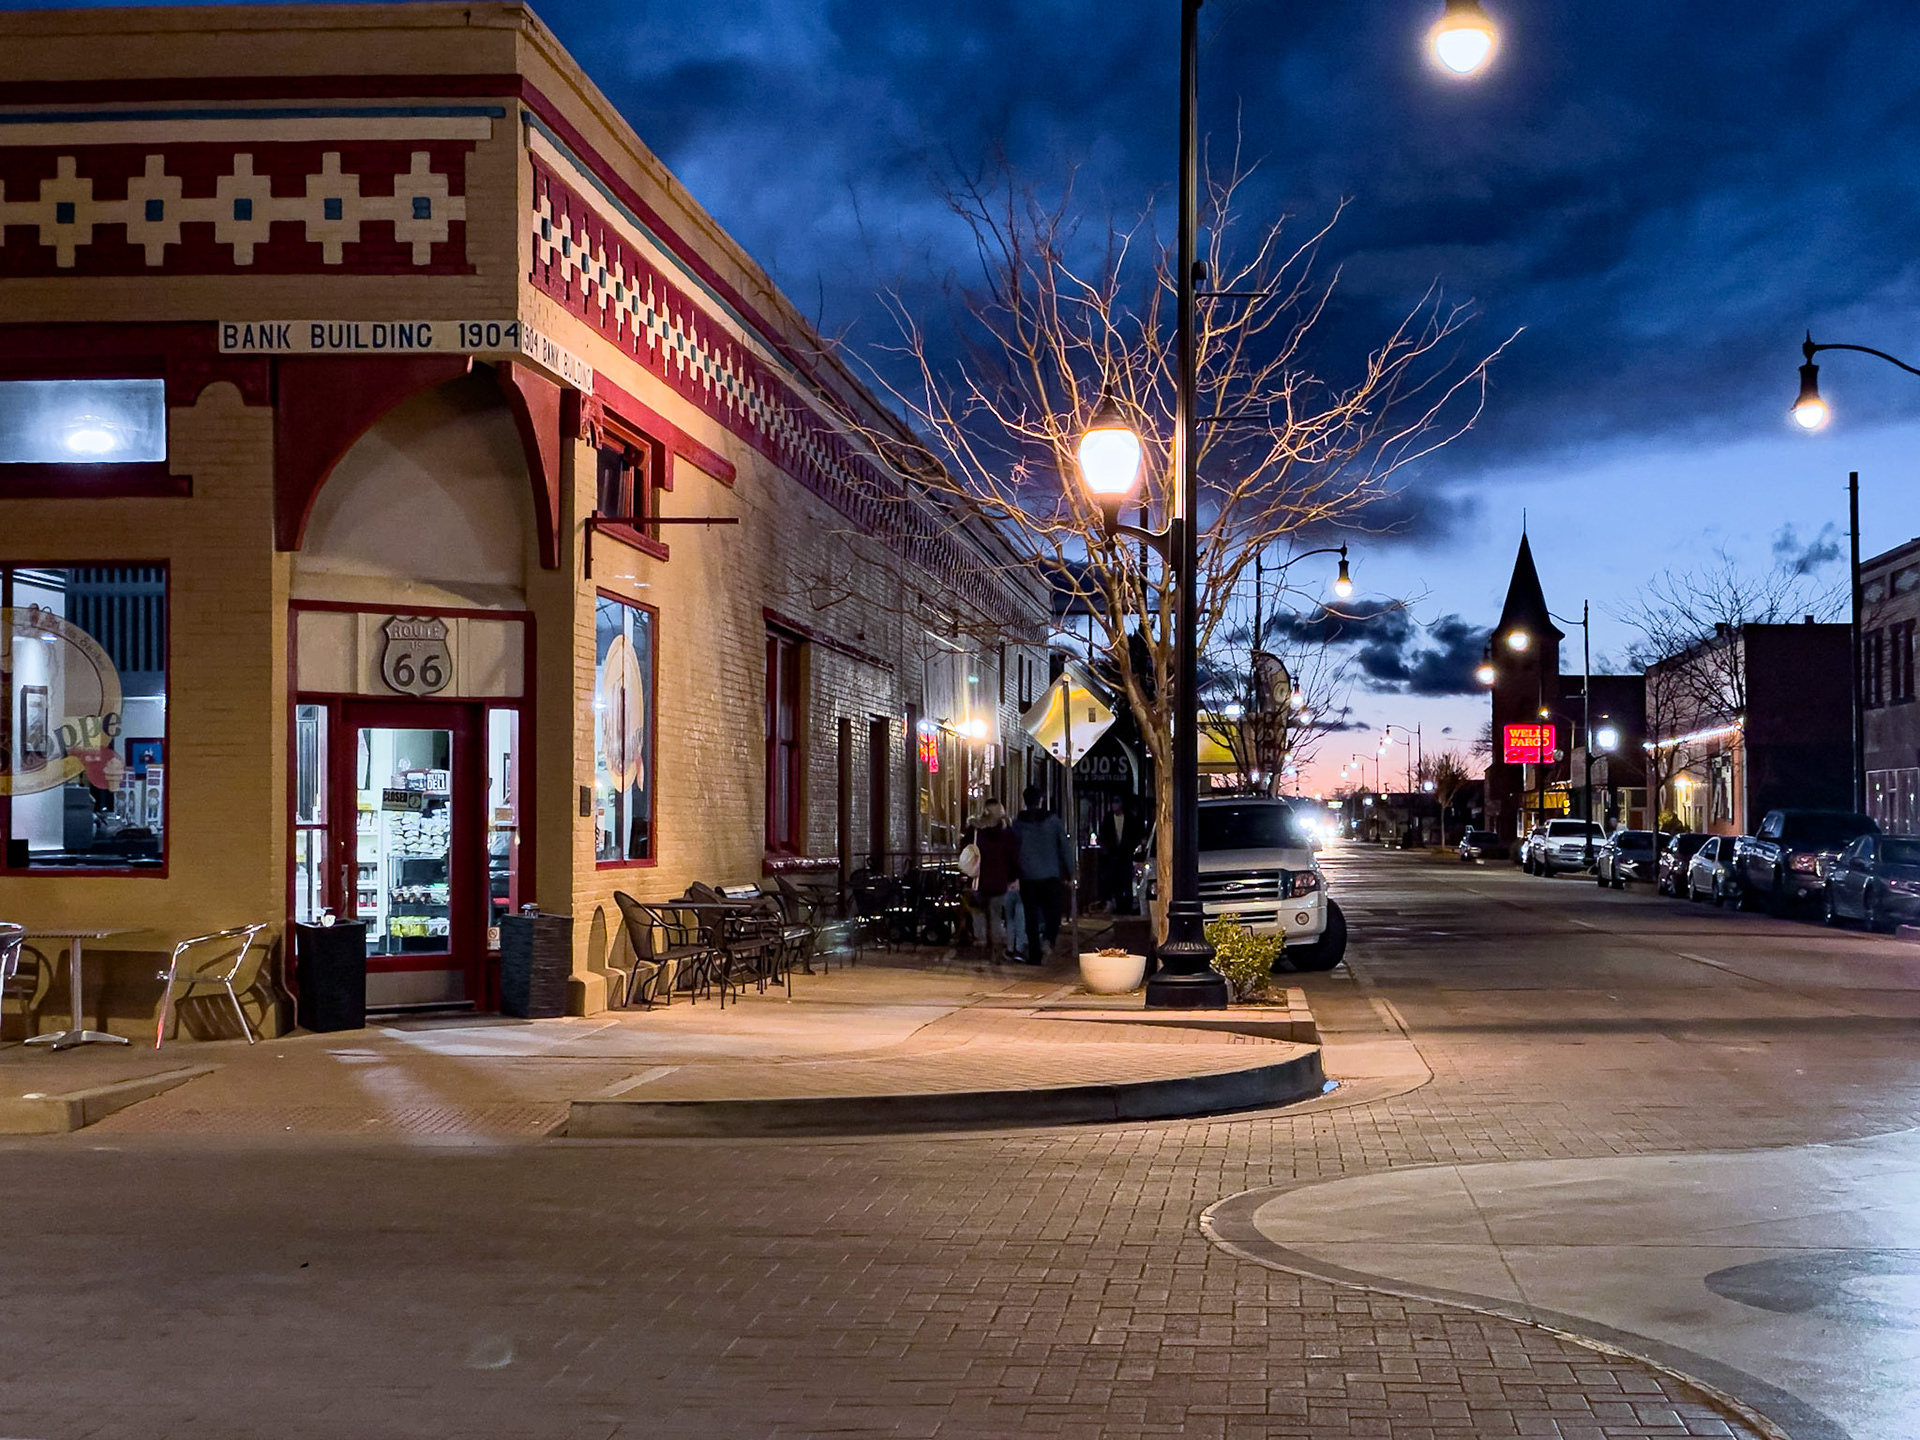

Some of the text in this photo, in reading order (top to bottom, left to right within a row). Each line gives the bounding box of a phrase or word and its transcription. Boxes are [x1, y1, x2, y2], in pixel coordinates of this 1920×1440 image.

[223, 324, 291, 348] BANK
[459, 323, 519, 348] 1904
[392, 625, 441, 638] ROUTE
[393, 653, 442, 687] 66
[1509, 729, 1550, 737] WELLS
[1510, 738, 1550, 746] FARGO
[1074, 755, 1129, 774] OJO'S
[427, 780, 446, 790] DELI
[384, 791, 408, 803] CLOSED
